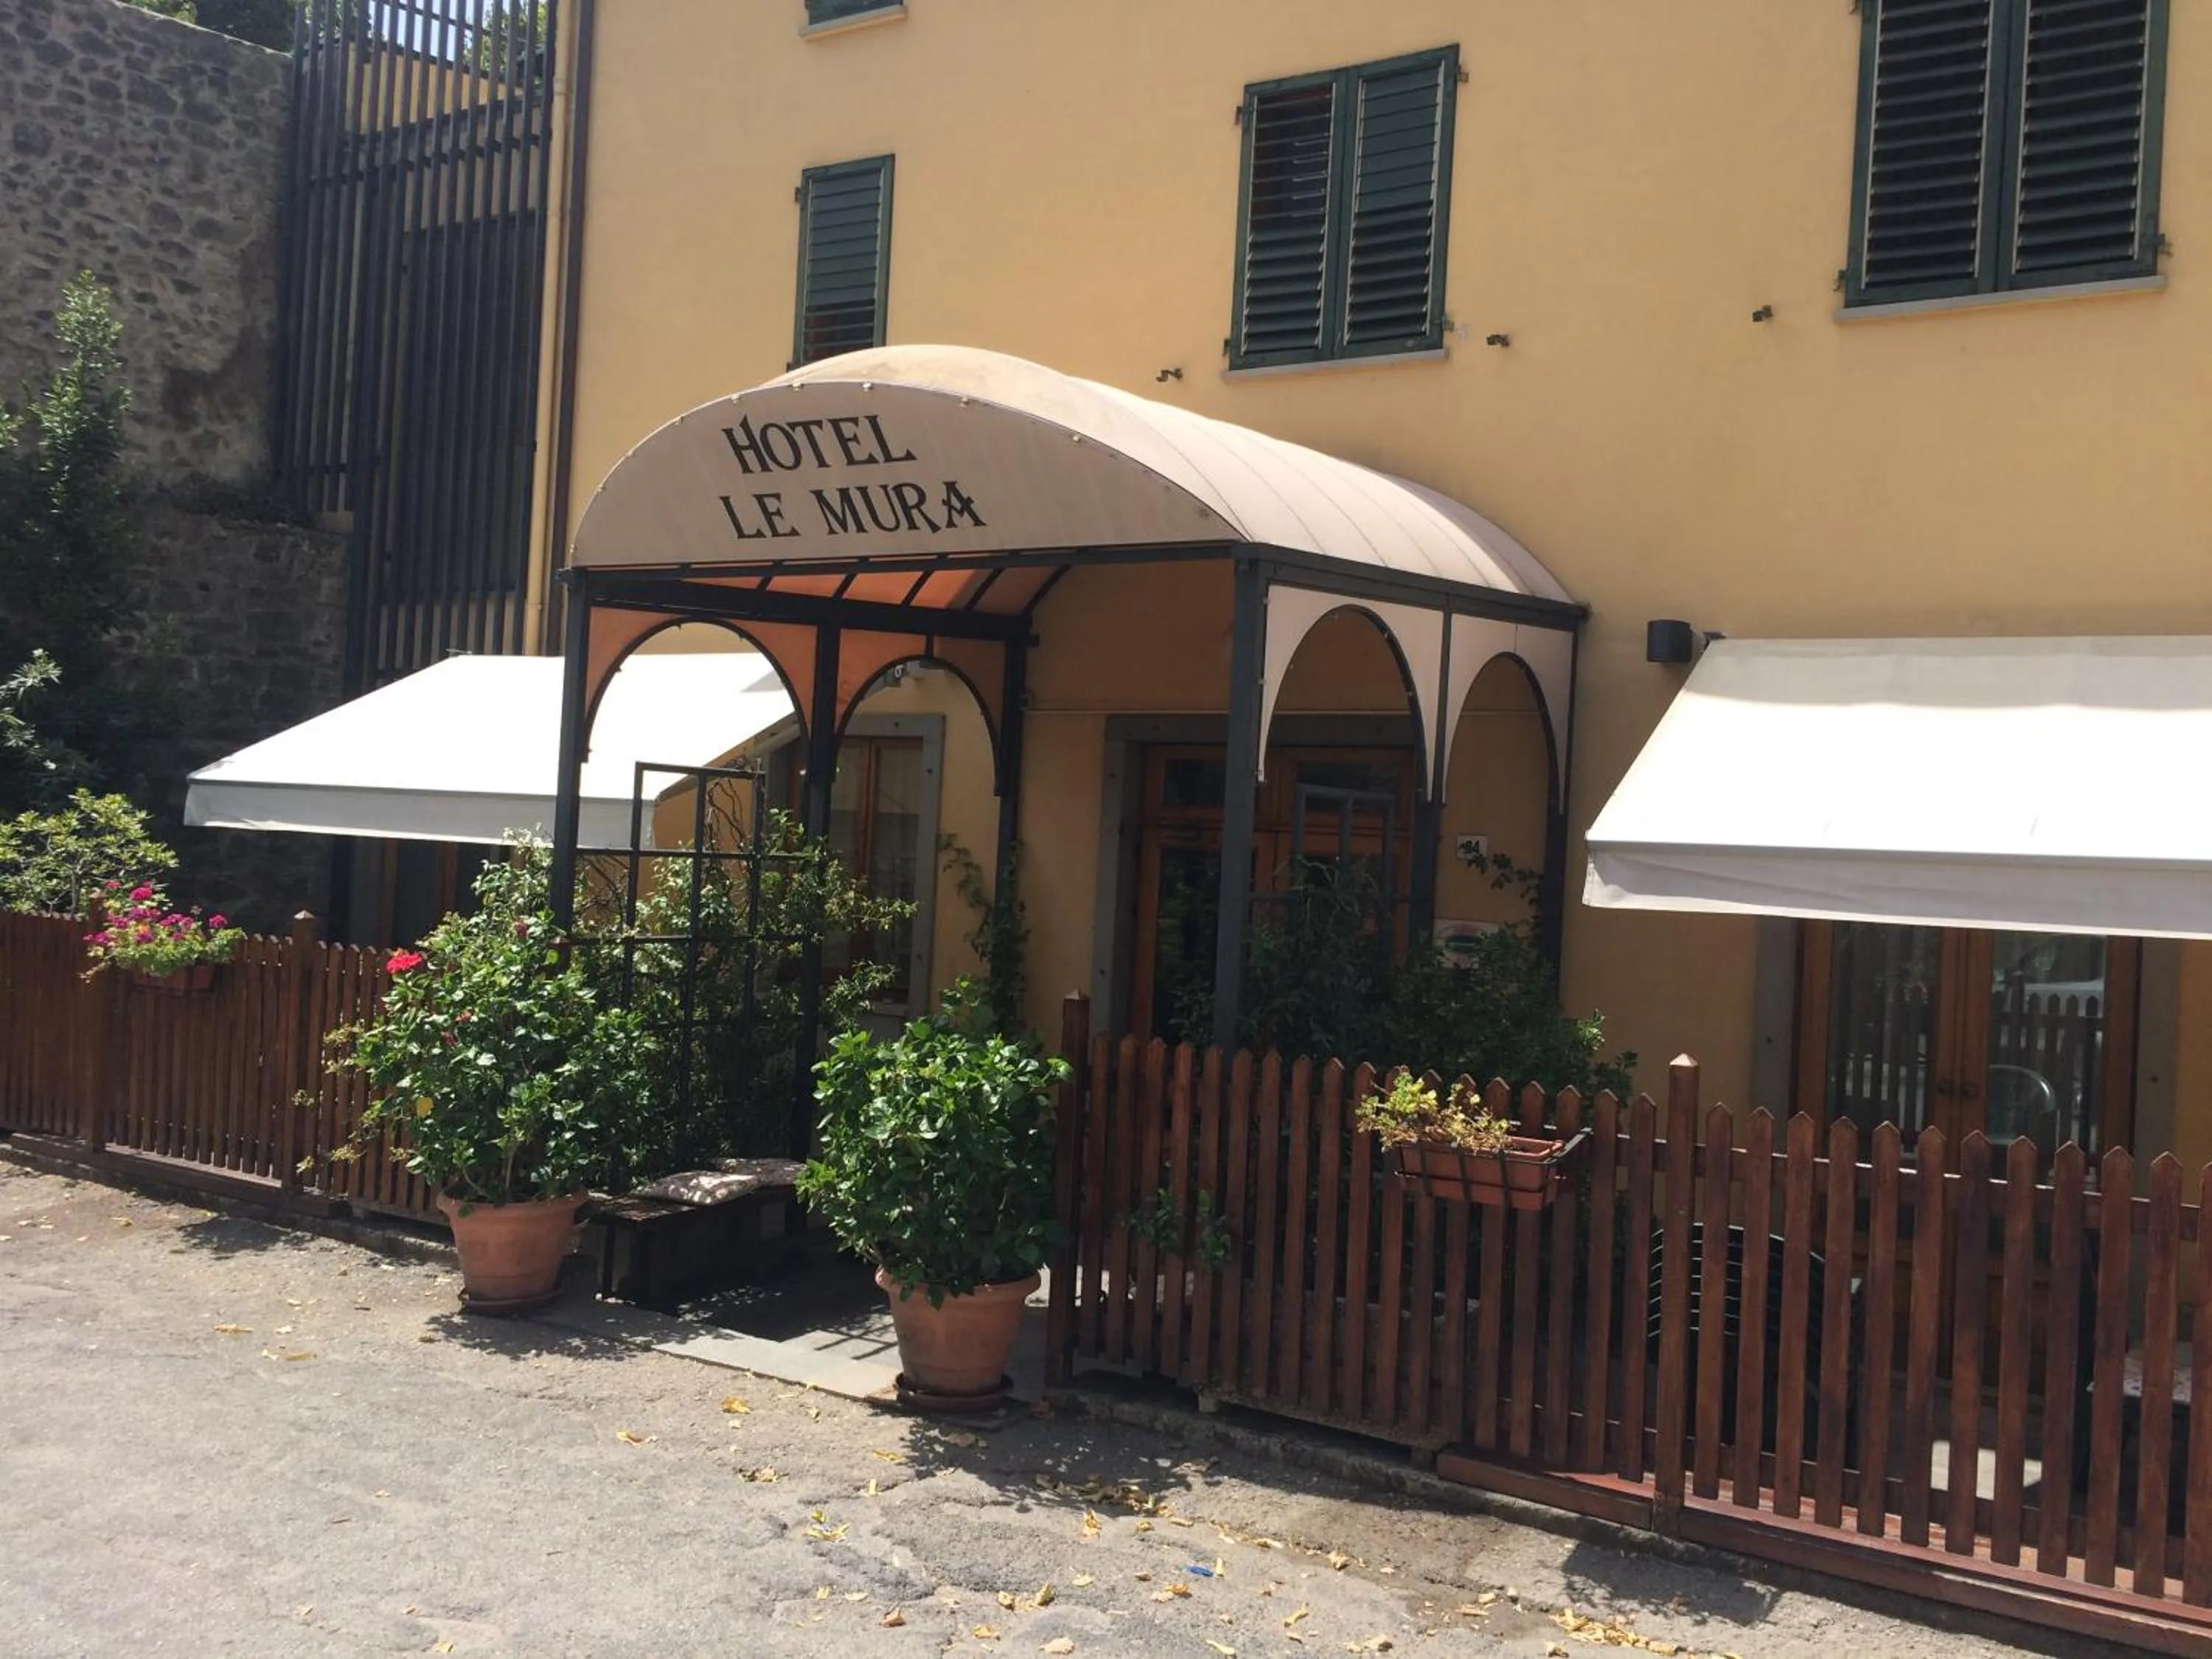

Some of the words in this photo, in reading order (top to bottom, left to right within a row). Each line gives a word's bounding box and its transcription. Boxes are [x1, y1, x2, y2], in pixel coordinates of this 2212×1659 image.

[720, 414, 917, 474] HOTEL
[719, 493, 801, 539] LE
[809, 480, 988, 535] MURA
